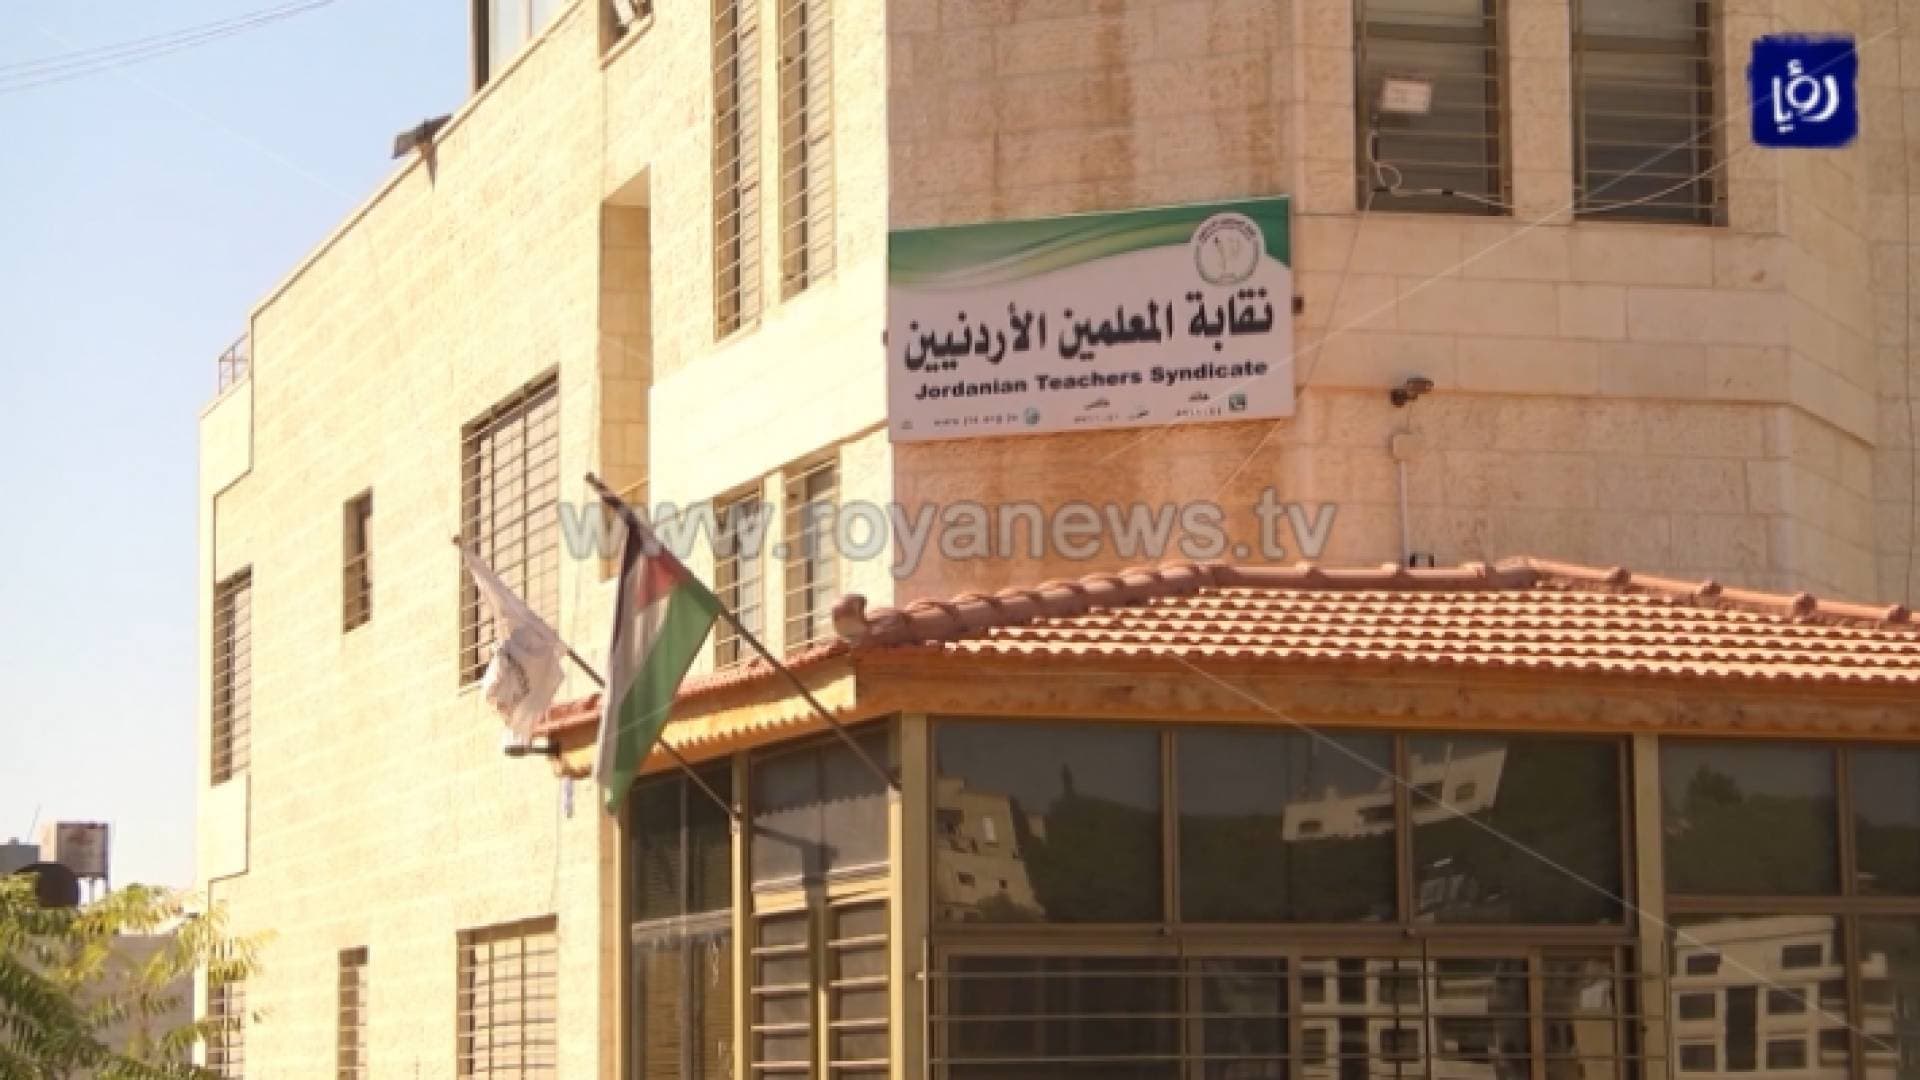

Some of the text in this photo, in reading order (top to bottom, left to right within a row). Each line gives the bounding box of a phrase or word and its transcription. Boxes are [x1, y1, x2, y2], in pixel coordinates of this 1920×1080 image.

[904, 287, 1274, 372] نقابة المعلمين الأردنيين
[914, 359, 1270, 401] Jordanian Teachers Syndicate
